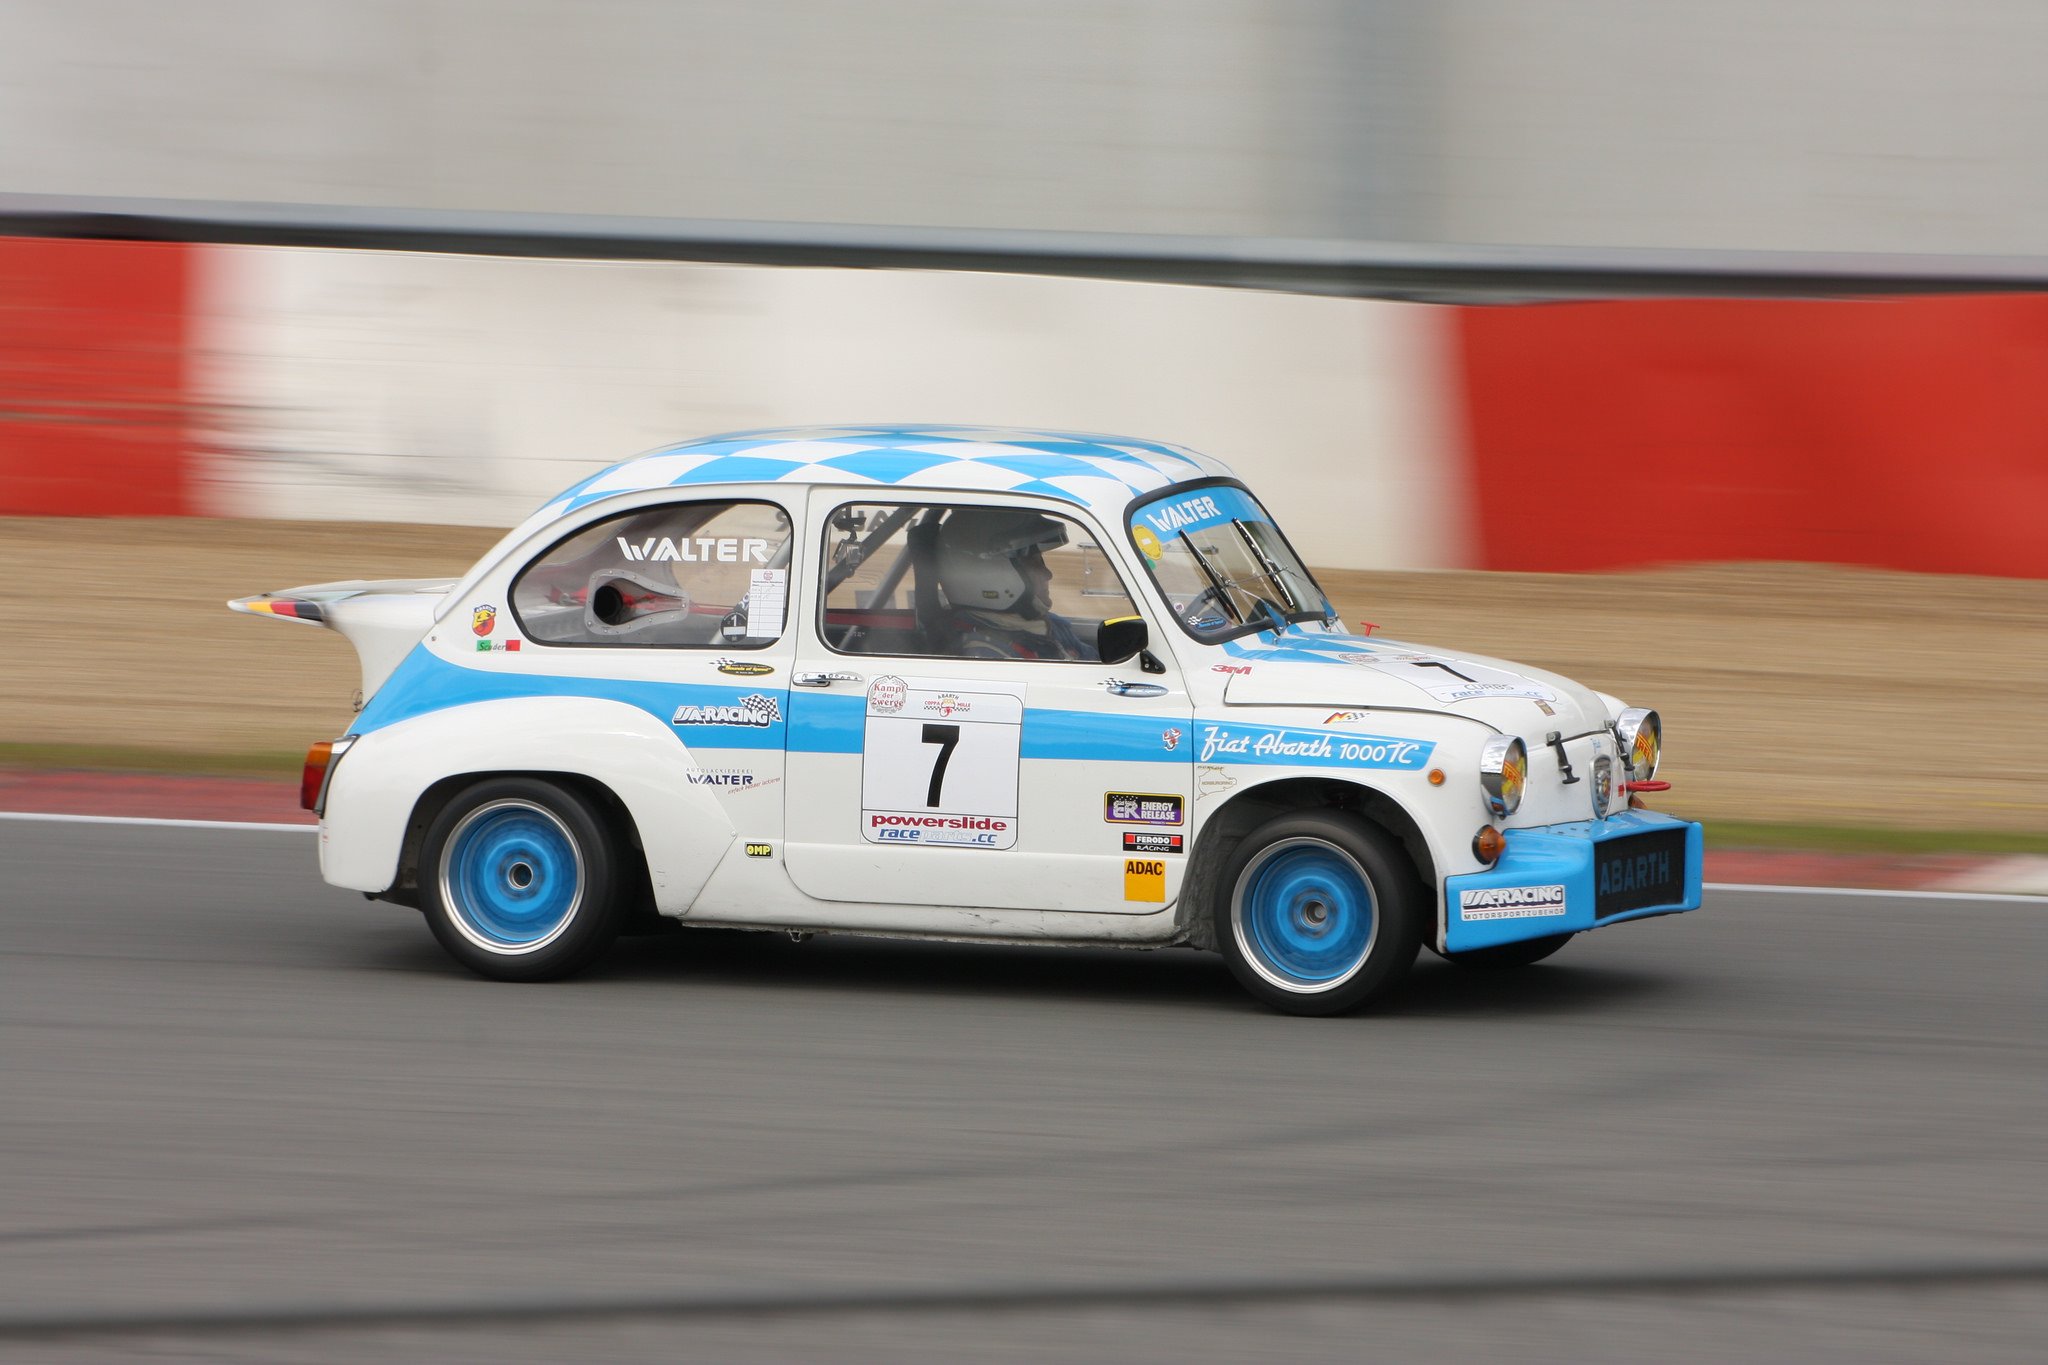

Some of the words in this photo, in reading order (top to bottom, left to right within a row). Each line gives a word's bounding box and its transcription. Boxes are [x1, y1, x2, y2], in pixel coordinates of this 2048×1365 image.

[1146, 496, 1222, 532] WALTER
[616, 536, 770, 562] WALTER
[1211, 664, 1253, 675] 3M
[1410, 661, 1477, 683] 7
[874, 683, 906, 694] Kampf
[1463, 683, 1514, 691] CURBS
[871, 697, 904, 708] Zwerge
[1200, 726, 1251, 762] Fiat
[1253, 730, 1332, 758] Abarth
[922, 723, 960, 808] 7
[686, 773, 754, 785] WALTER
[1112, 799, 1140, 819] ER
[1141, 801, 1174, 812] ENERGY
[1141, 810, 1175, 821] RELEASE
[871, 815, 1007, 831] powerslide
[1136, 836, 1170, 844] FERODO
[746, 845, 771, 856] OMP
[1126, 861, 1163, 876] ADAC
[1600, 851, 1670, 896] ABARTH
